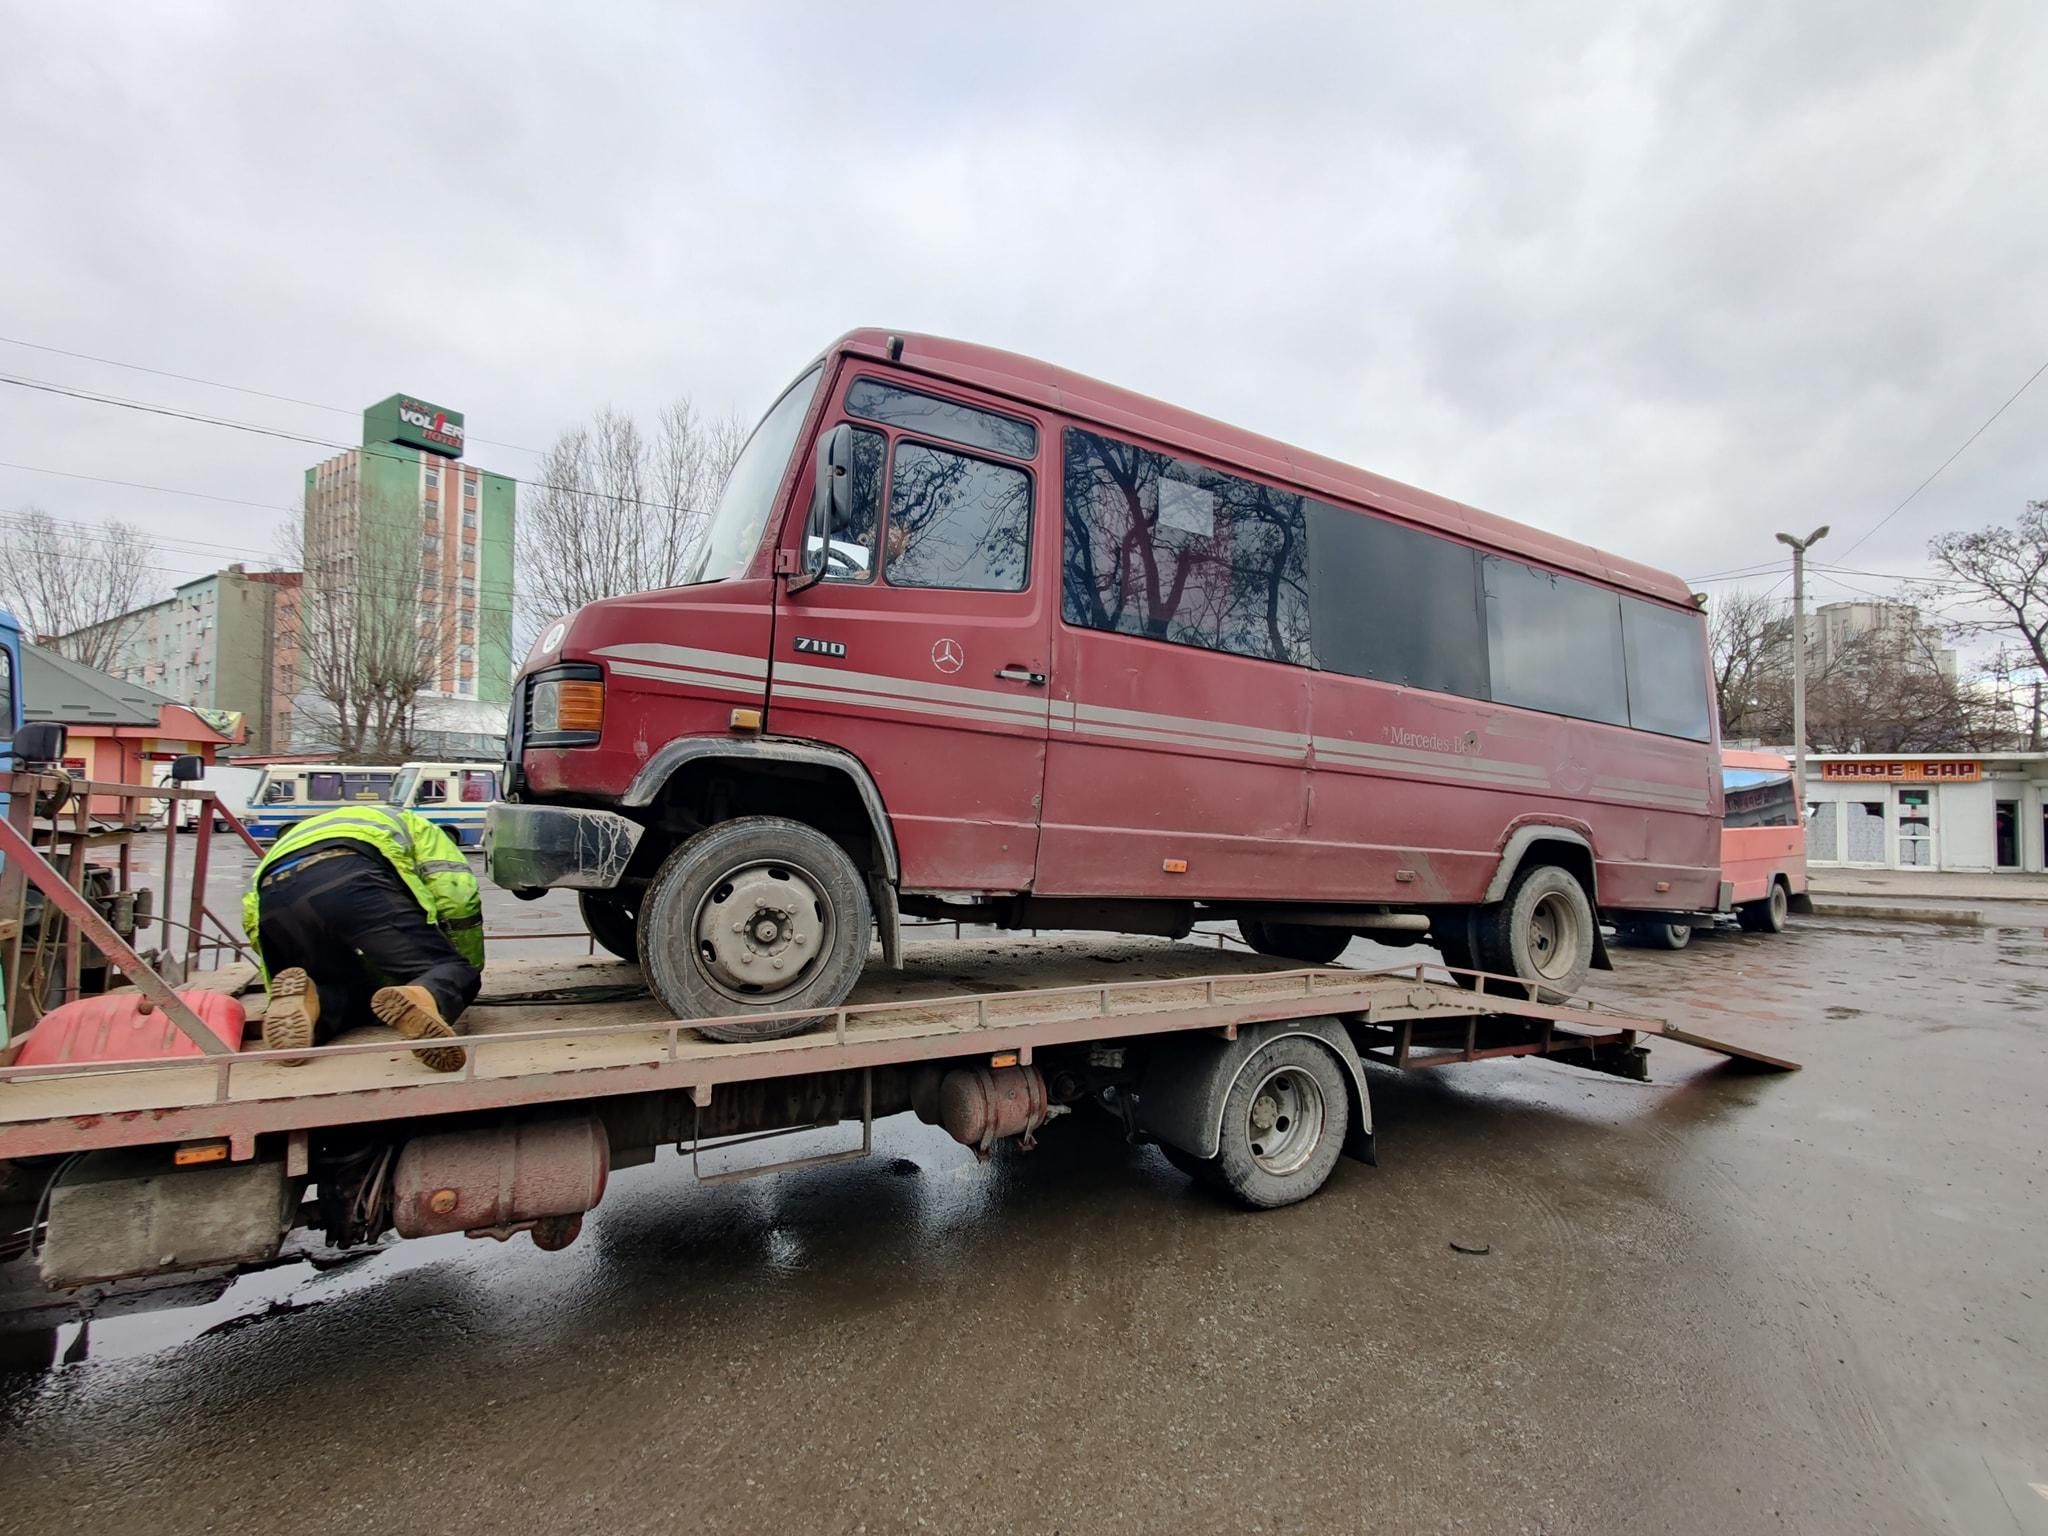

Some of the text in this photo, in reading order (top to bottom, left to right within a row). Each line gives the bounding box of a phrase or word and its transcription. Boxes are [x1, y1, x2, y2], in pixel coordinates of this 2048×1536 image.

[422, 430, 463, 448] HOTEL
[1827, 763, 1905, 777] КАФЕ
[1922, 763, 1976, 777] БАР
